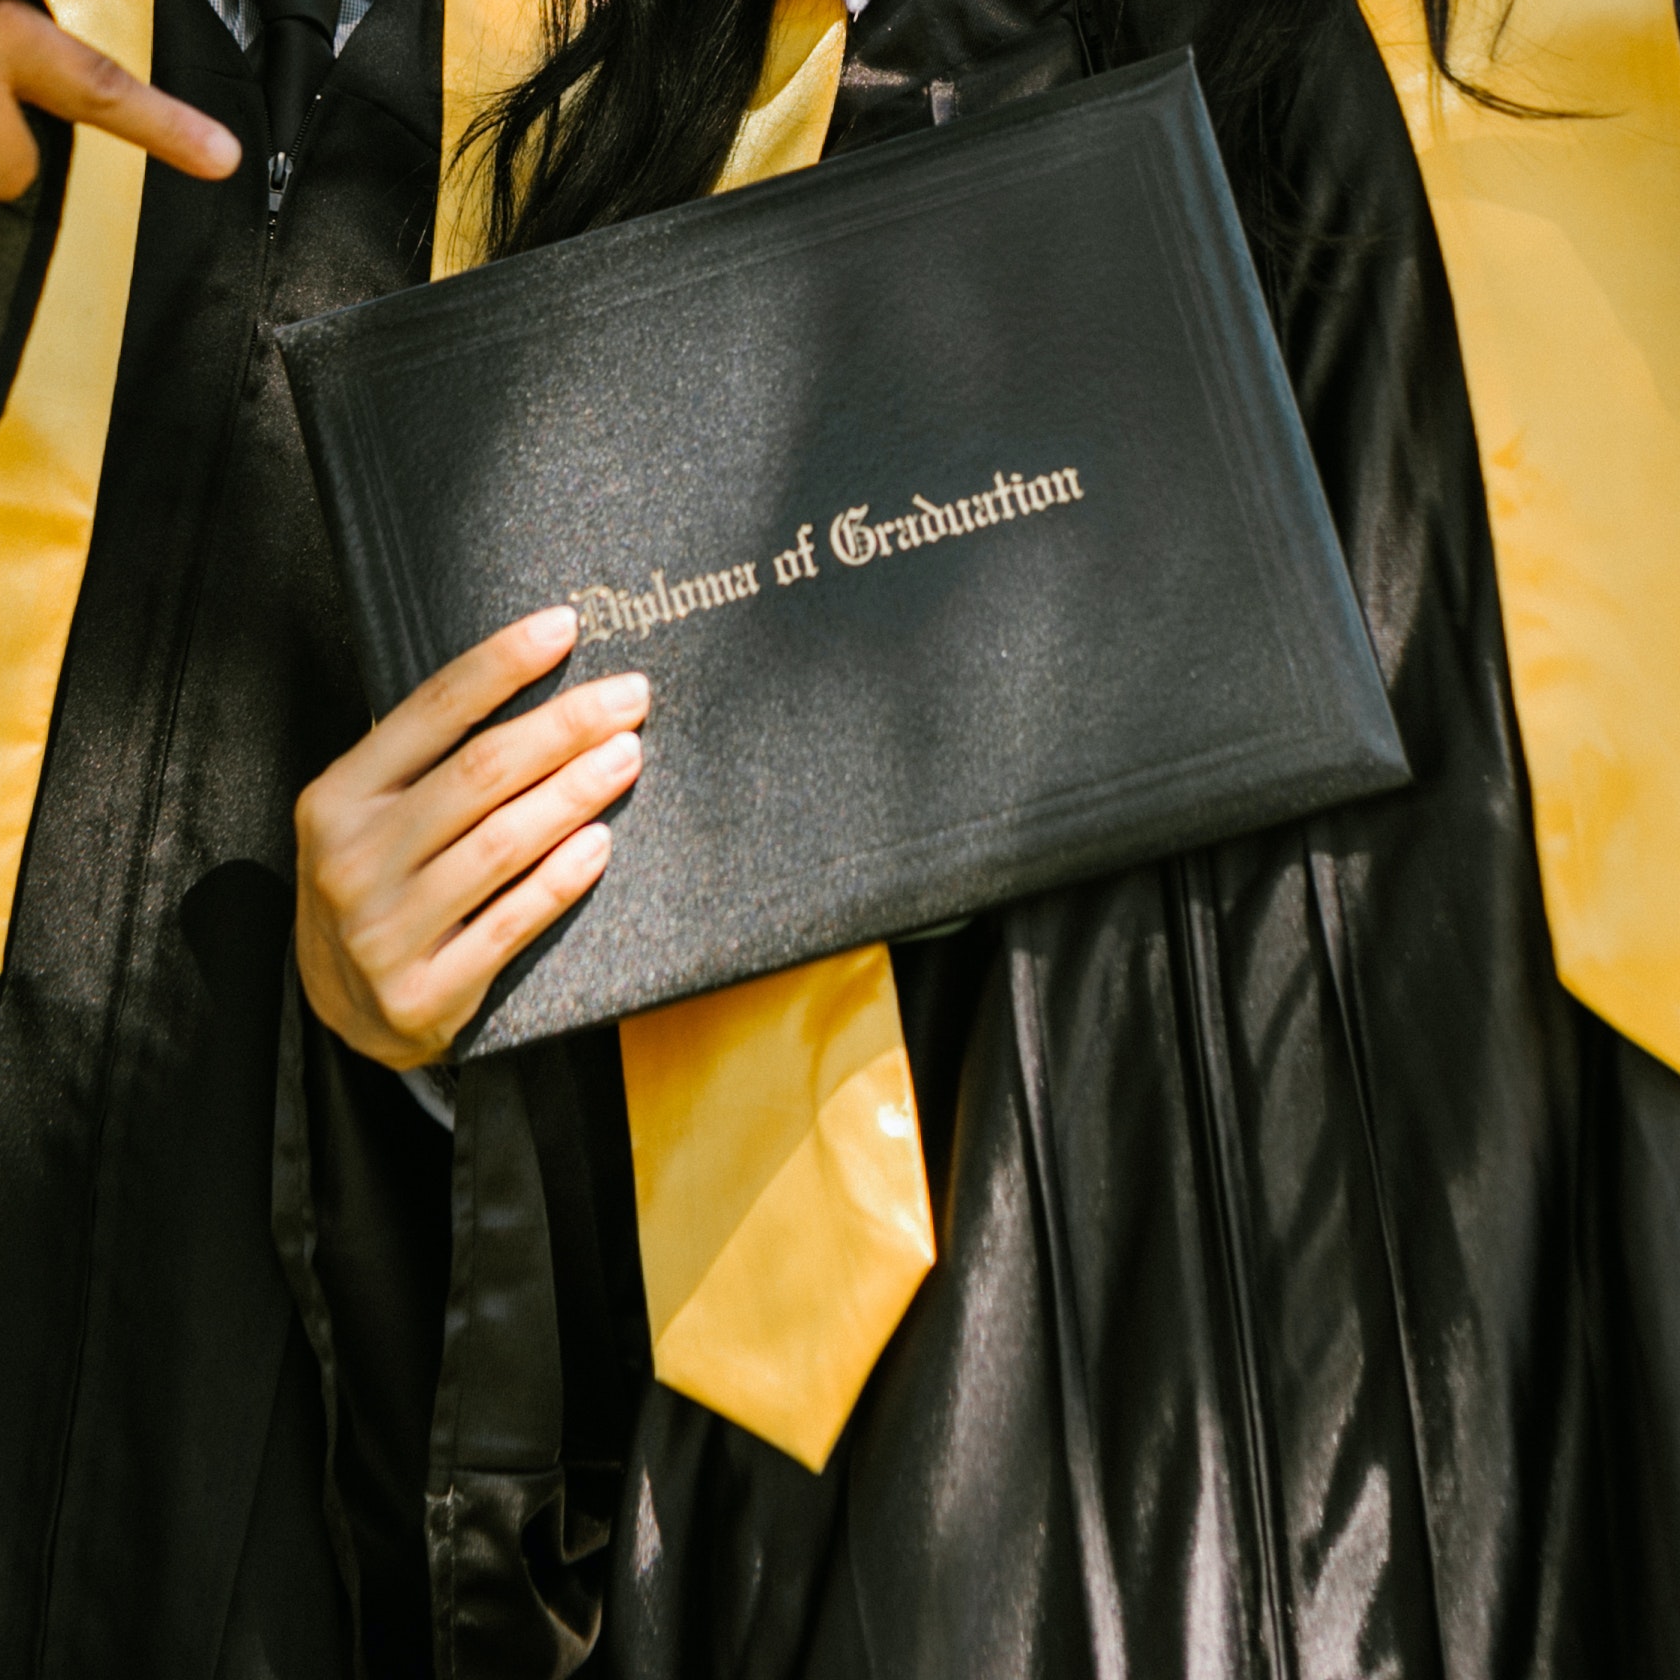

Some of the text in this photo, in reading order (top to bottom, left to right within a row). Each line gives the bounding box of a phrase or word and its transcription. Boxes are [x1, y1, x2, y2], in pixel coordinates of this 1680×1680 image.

[569, 466, 1084, 646] Diploma of Graduation
